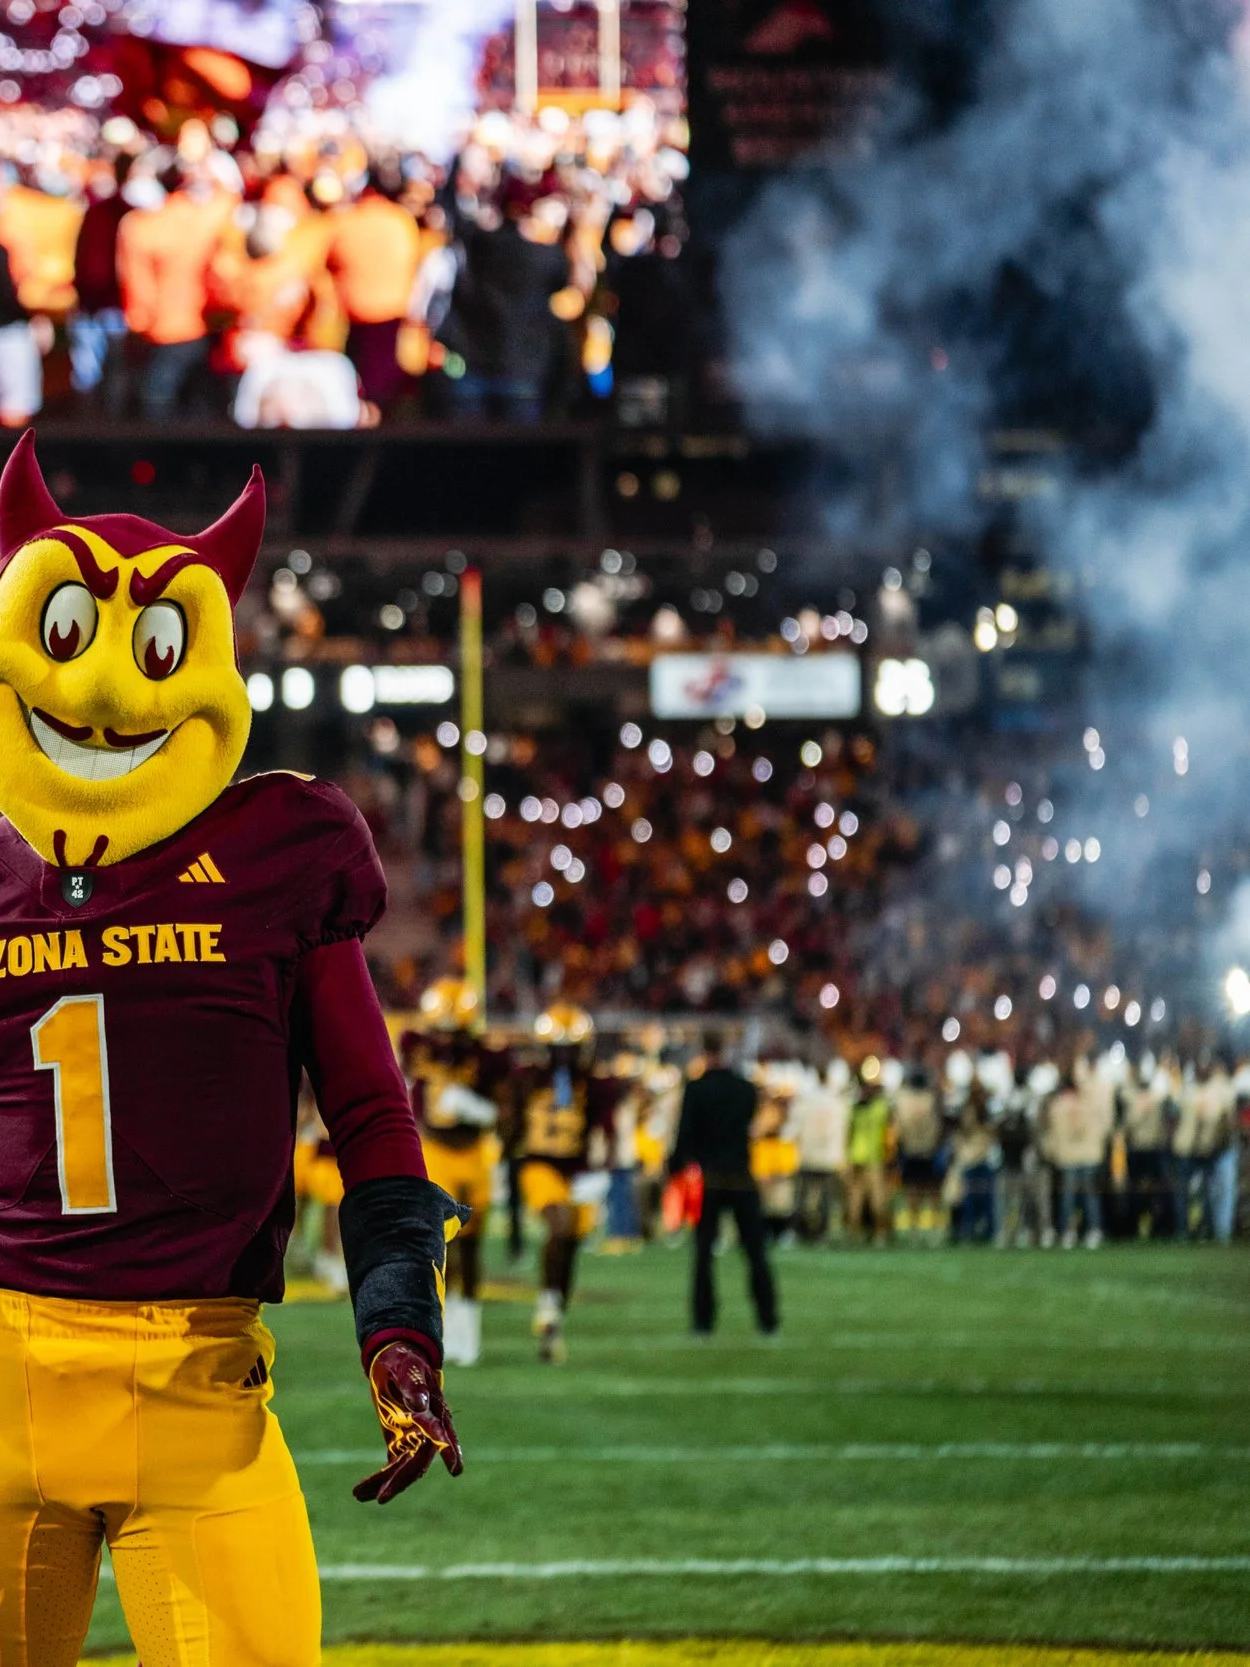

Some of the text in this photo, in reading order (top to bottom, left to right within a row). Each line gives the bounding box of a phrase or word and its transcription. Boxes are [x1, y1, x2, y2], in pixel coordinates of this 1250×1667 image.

[71, 876, 84, 886] PT
[71, 889, 84, 899] 42
[101, 923, 226, 966] STATE
[30, 992, 117, 1216] 1
